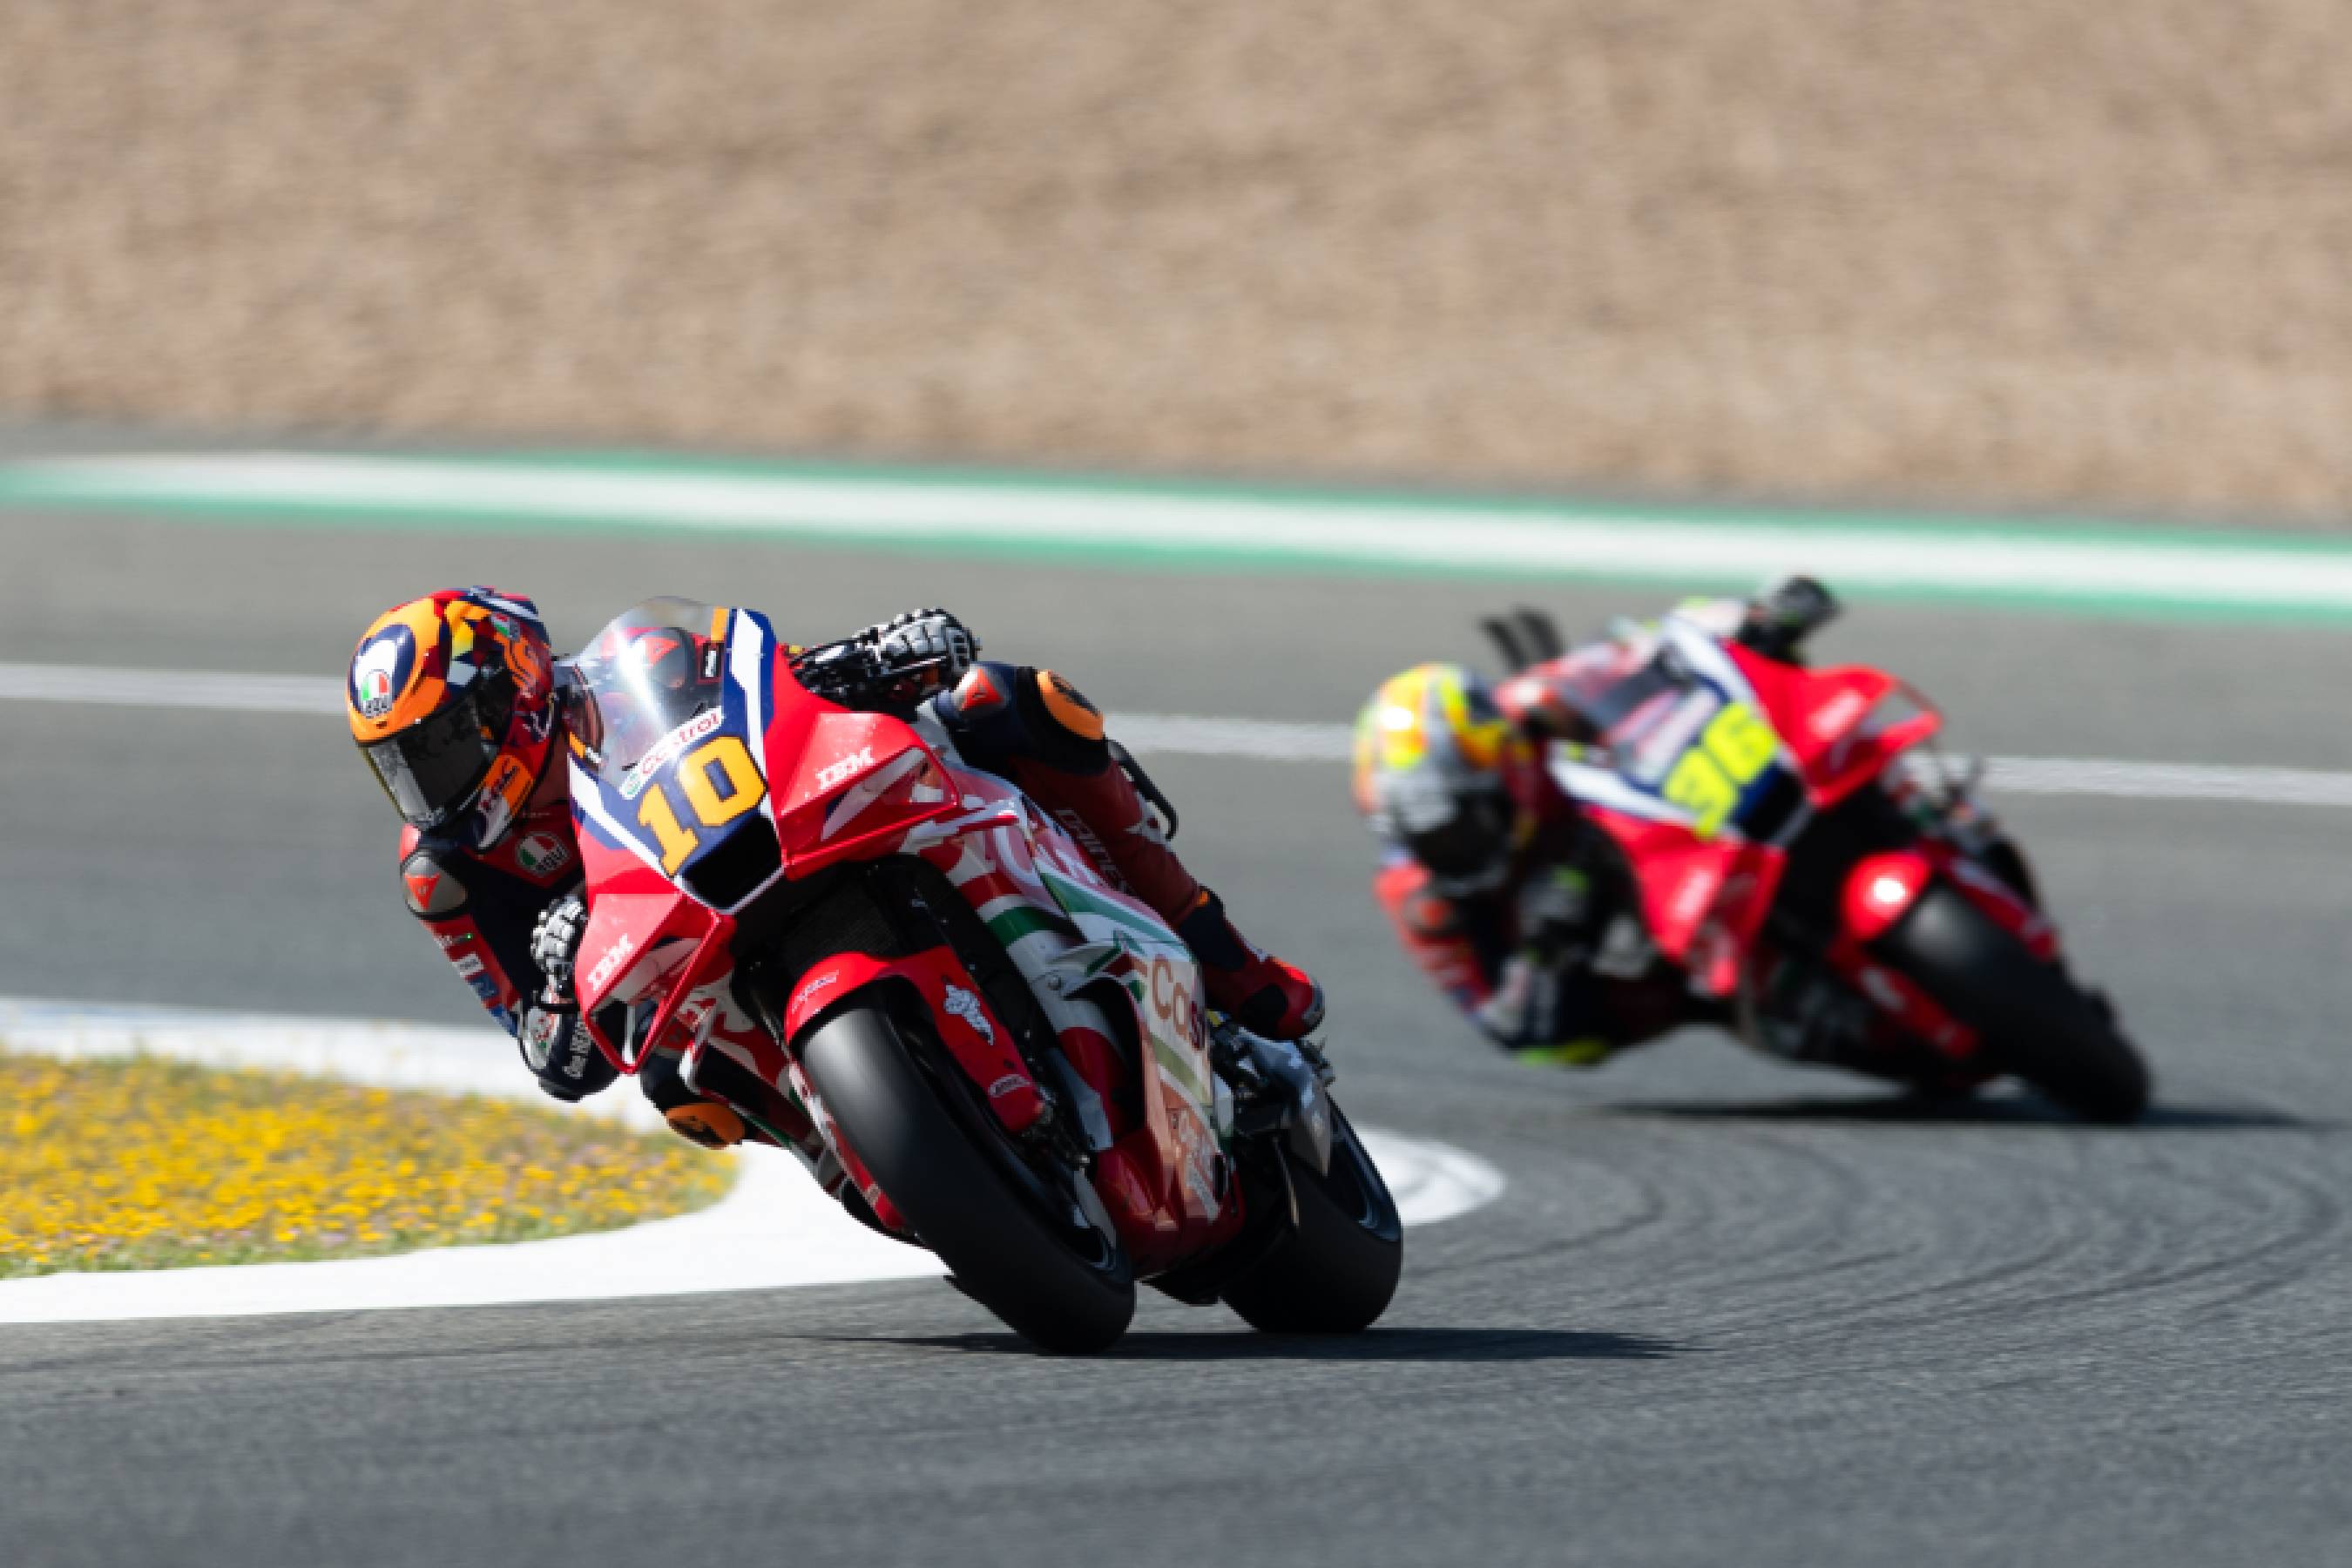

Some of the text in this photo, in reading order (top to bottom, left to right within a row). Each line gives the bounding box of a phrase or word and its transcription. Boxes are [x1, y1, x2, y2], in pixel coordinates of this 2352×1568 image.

[641, 712, 720, 776] Catrol
[815, 747, 875, 790] IBM
[1663, 700, 1778, 841] 36
[638, 735, 767, 876] 10
[586, 933, 633, 991] IBM
